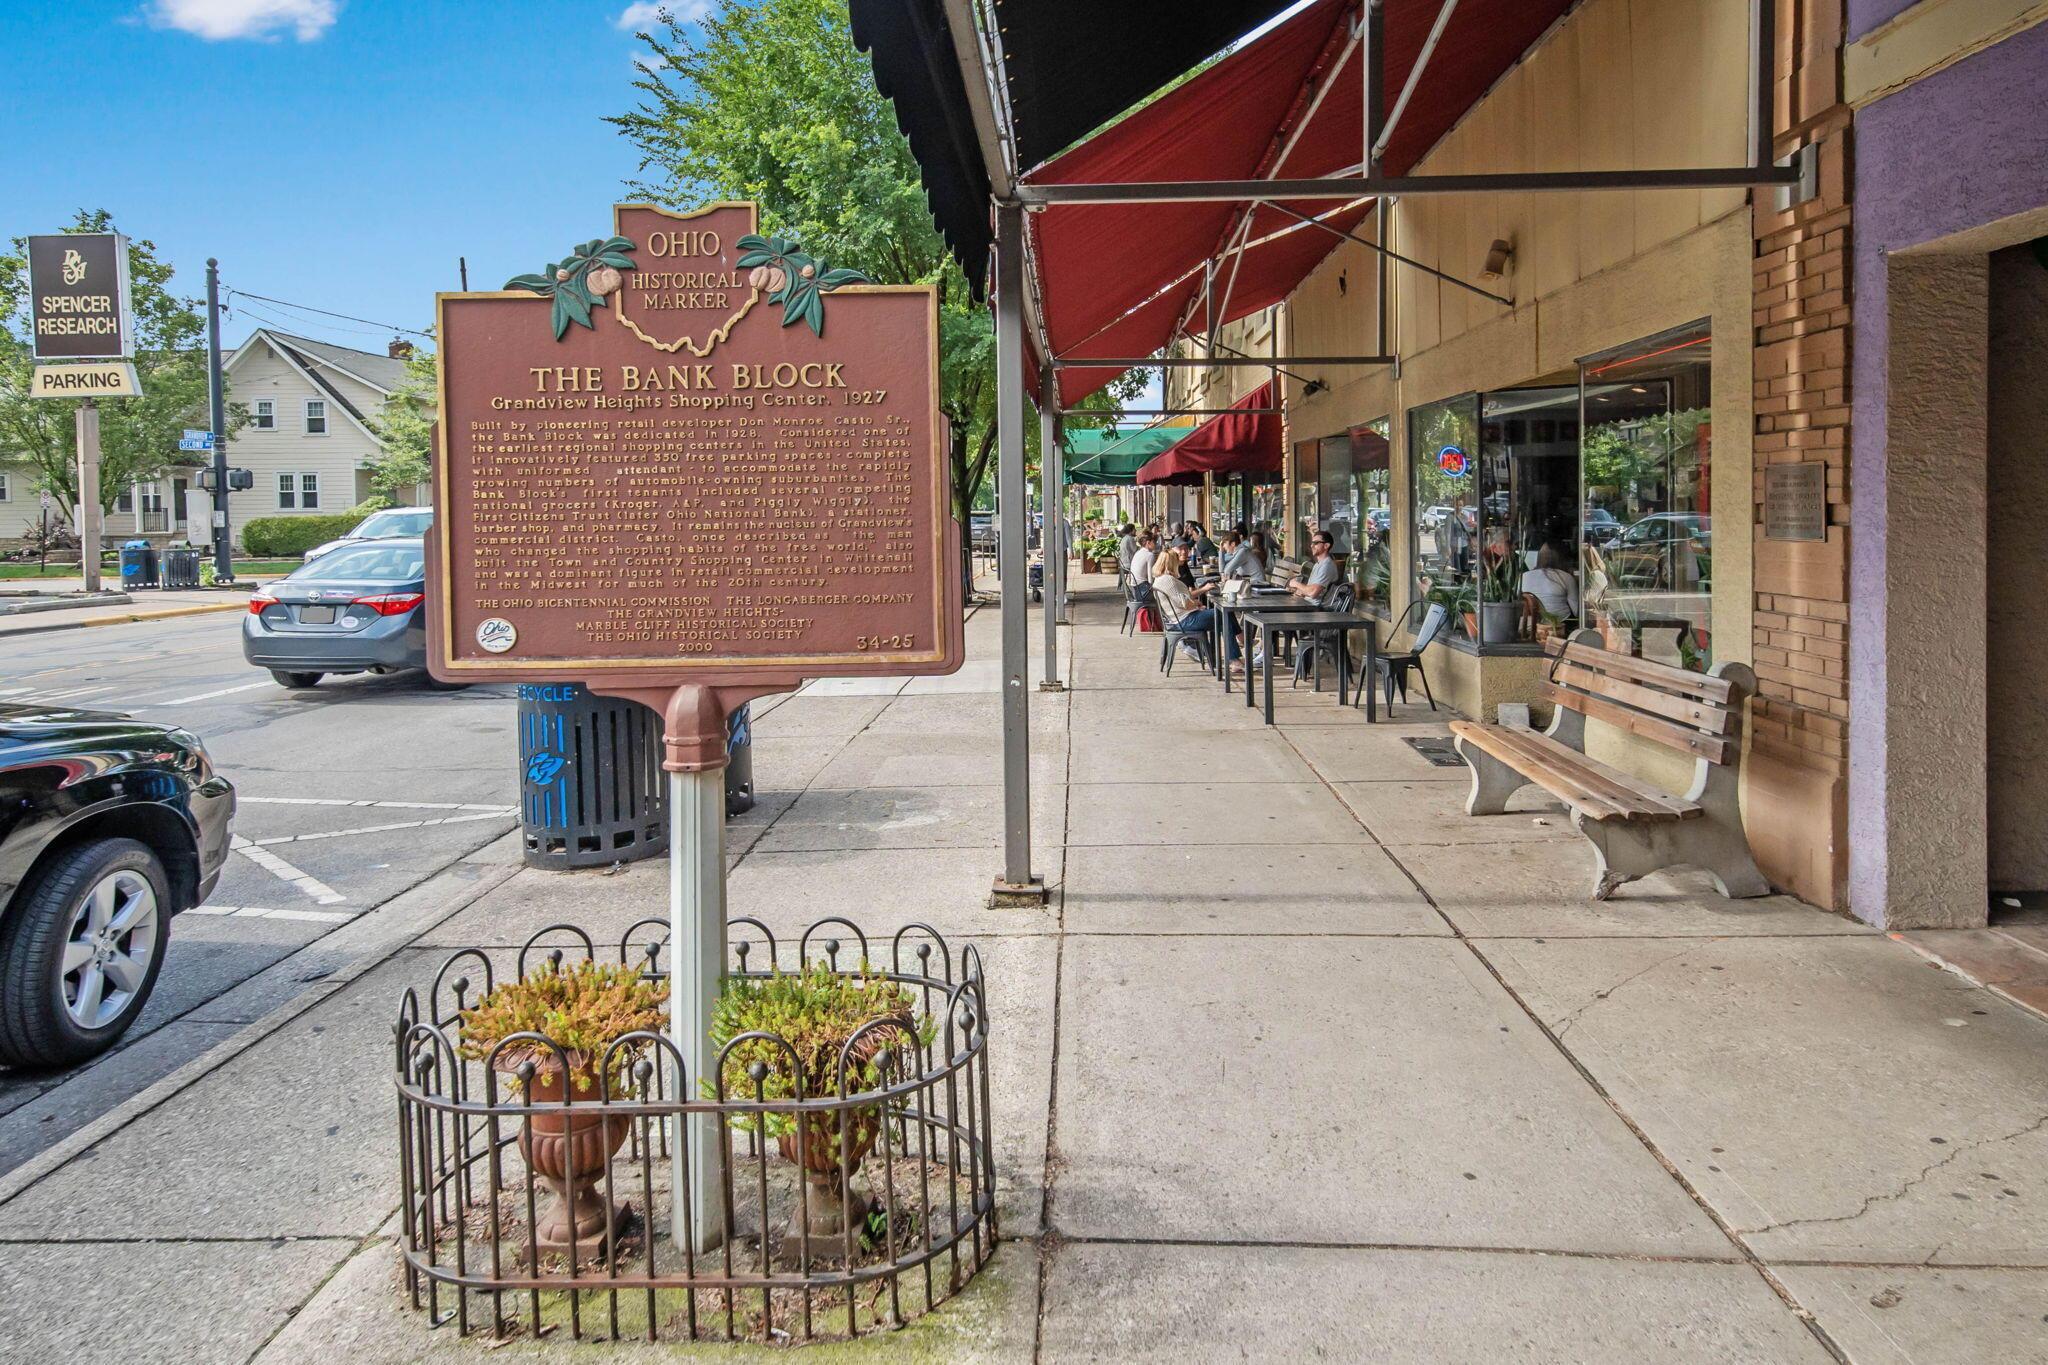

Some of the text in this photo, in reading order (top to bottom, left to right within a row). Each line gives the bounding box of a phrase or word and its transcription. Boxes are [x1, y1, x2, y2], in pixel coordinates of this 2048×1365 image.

[648, 231, 721, 257] OHIO
[632, 272, 743, 290] HISTORICAL
[42, 296, 111, 313] SPENCER
[644, 292, 729, 309] MARKER
[38, 317, 117, 335] RESEARCH
[43, 372, 120, 389] PARKING
[529, 362, 846, 391] THE BANK BLOCK
[490, 395, 587, 409] Grandview
[593, 394, 661, 411] Heights
[669, 393, 753, 409] Shopping
[843, 390, 886, 404] 1927
[470, 420, 501, 430] Built
[510, 420, 526, 431] by
[536, 419, 608, 430] pioneering
[617, 418, 654, 428] retail
[662, 418, 731, 428] developer
[739, 417, 767, 426] Don
[772, 416, 823, 425] Monroe
[832, 416, 872, 424] Casto
[471, 432, 493, 441] the
[502, 432, 535, 441] Bank
[544, 431, 582, 440] Block
[624, 430, 694, 439] dedicated
[779, 427, 855, 436] Considered
[863, 427, 886, 435] one
[472, 444, 493, 452] the
[498, 443, 552, 452] earliest
[557, 442, 614, 453] regional
[621, 441, 682, 452] shopping
[688, 441, 741, 449] centers
[804, 439, 849, 447] United
[490, 449, 909, 464] innovatively featured 350 free parking spaces complete
[472, 461, 910, 475] with uniformed attendant accommodate the rapidly
[471, 478, 527, 489] growing
[537, 477, 594, 488] numbers
[884, 472, 910, 481] The
[472, 489, 504, 498] Bank
[583, 488, 617, 497] first
[627, 488, 681, 496] tenants
[696, 486, 757, 495] included
[770, 485, 824, 494] several
[837, 483, 910, 494] competing
[473, 500, 531, 509] national
[541, 501, 595, 511] grocers
[720, 498, 744, 506] and
[753, 497, 800, 508] Piggly
[472, 512, 503, 521] First
[509, 512, 564, 521] Citizens
[571, 511, 609, 520] Trust
[617, 510, 658, 519] (later
[665, 509, 696, 518] Ohio
[703, 509, 765, 518] National
[473, 523, 516, 532] barber
[562, 523, 584, 531] and
[688, 520, 739, 530] remains
[744, 520, 764, 529] the
[768, 519, 815, 528] nucleus
[473, 534, 549, 544] commercial
[692, 533, 725, 541] once
[735, 531, 805, 540] described
[887, 530, 911, 538] man
[473, 546, 499, 555] who
[510, 546, 566, 557] changed
[576, 546, 598, 554] the
[608, 544, 670, 555] shopping
[679, 544, 722, 553] habits
[755, 543, 776, 551] the
[786, 542, 816, 552] free
[885, 541, 912, 549] also
[474, 552, 912, 567] built the Town and Country Shopping Center Whitehall
[474, 570, 496, 578] and
[549, 568, 611, 577] dominant
[618, 567, 662, 578] figure
[690, 566, 729, 575] retail
[737, 565, 817, 574] commercial
[826, 564, 912, 574] development
[497, 580, 520, 589] the
[528, 580, 585, 589] Midwest
[598, 579, 618, 588] for
[627, 578, 662, 588] much
[672, 578, 686, 587] of
[695, 578, 719, 586] the
[727, 576, 759, 587] 20th
[474, 593, 913, 608] THE OHIO BICENTENNIAL COMMISSION THE LONGABERGER COMPANY
[606, 609, 632, 618] THE
[637, 608, 716, 617] GRANDVIEW
[484, 621, 510, 635] Ohio
[575, 618, 813, 630] MARBLE CLIFF HISTORICAL SOCIETY
[586, 629, 801, 641] THE OHIO HISTORICAL SOCIETY
[856, 633, 913, 652] 34-25
[678, 642, 712, 651] 2000
